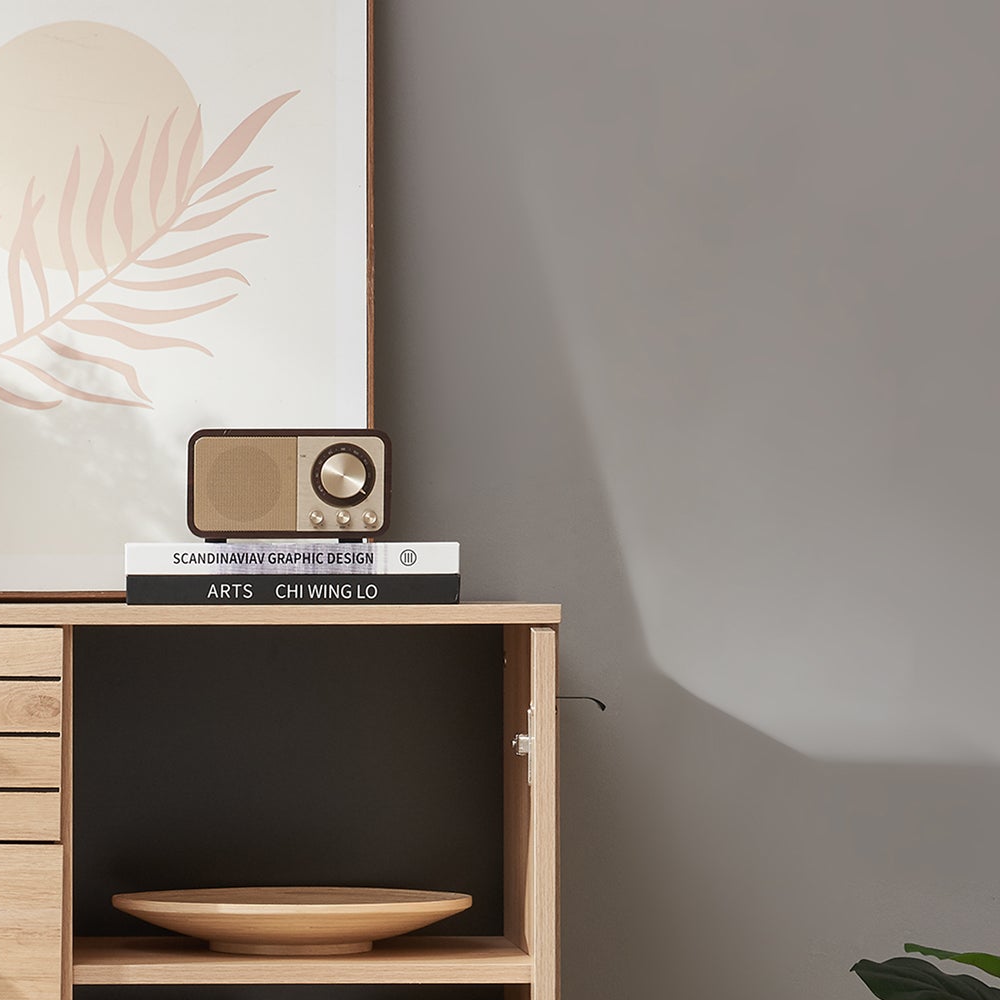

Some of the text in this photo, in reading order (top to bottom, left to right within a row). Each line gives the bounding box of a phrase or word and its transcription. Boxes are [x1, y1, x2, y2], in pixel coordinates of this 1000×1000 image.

[173, 552, 374, 565] SCANDINAVIAV GRAPHIC DESIGN
[207, 584, 378, 599] ARTS CHI WING LO
